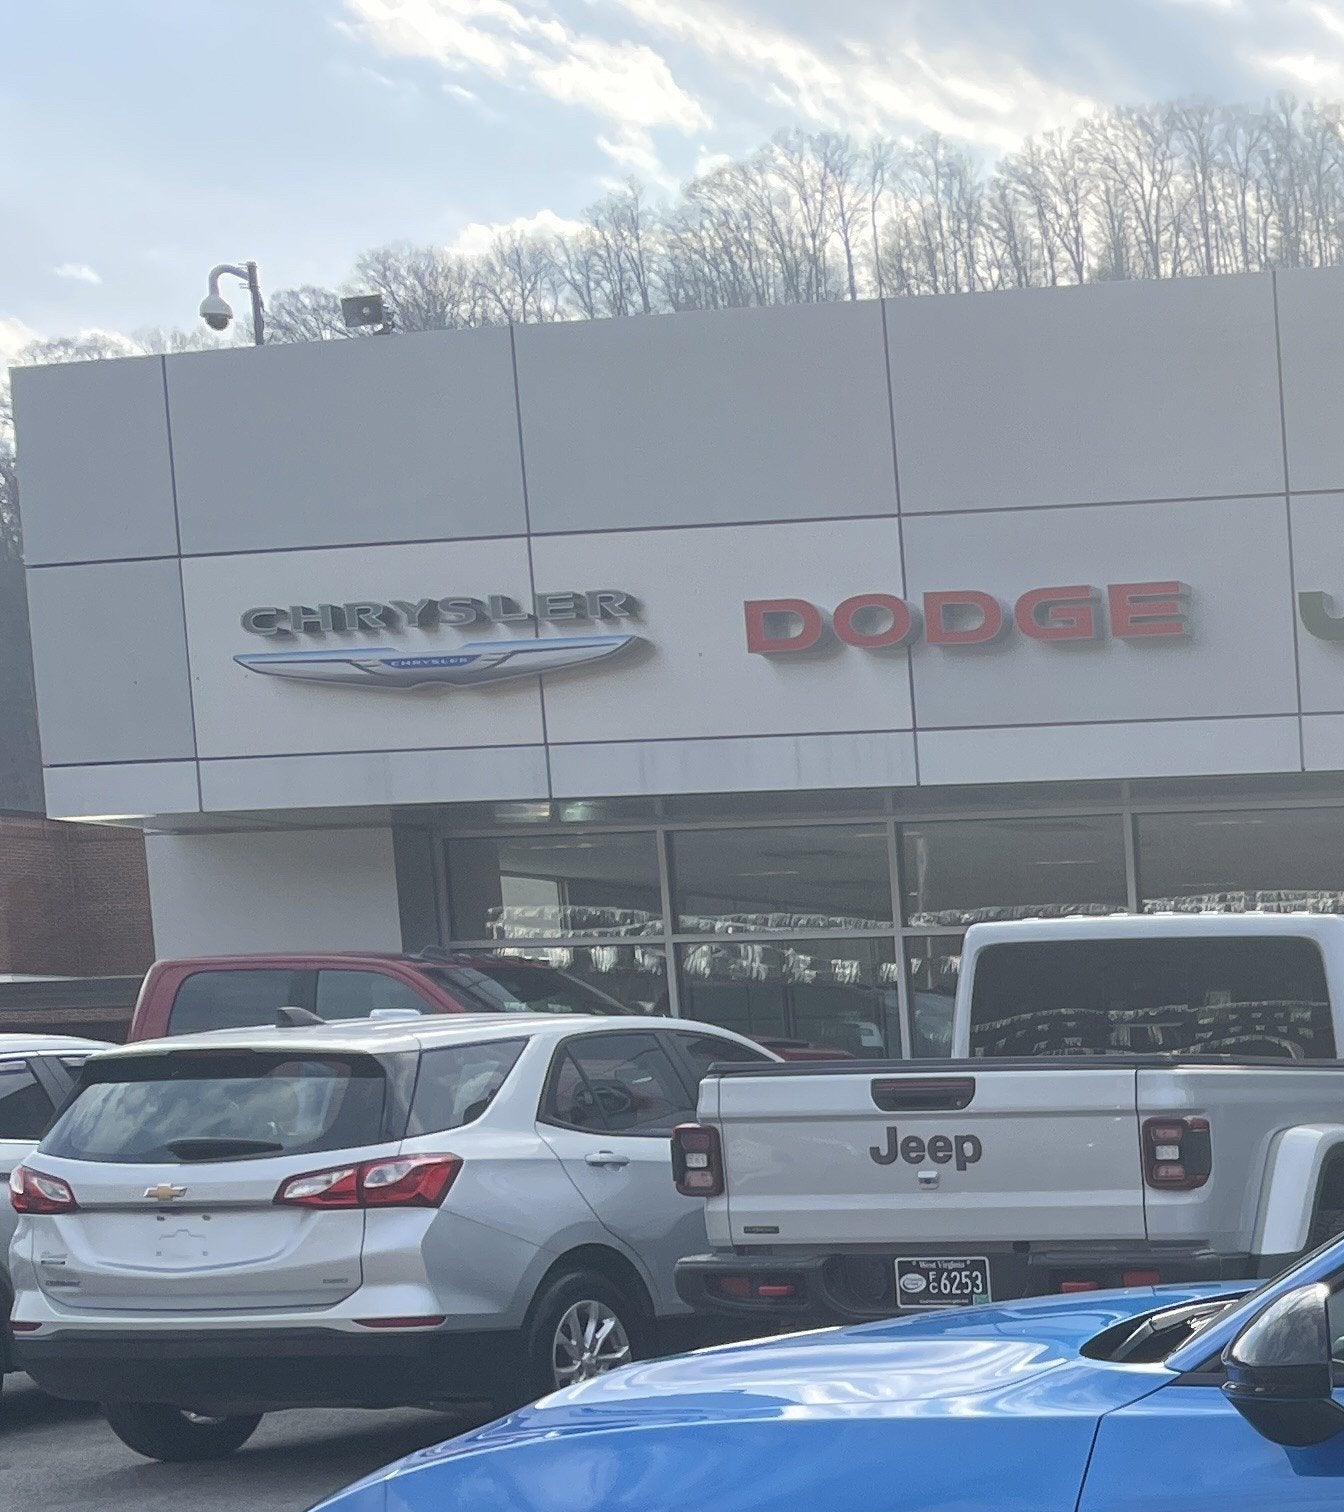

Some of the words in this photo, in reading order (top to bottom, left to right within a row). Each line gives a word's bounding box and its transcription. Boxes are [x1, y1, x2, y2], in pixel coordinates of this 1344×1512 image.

[240, 588, 637, 637] CHRYSLER
[744, 580, 1189, 653] DODGE
[391, 657, 468, 666] CHRYSLER
[869, 1126, 982, 1171] Jeep
[941, 1271, 983, 1294] 6253
